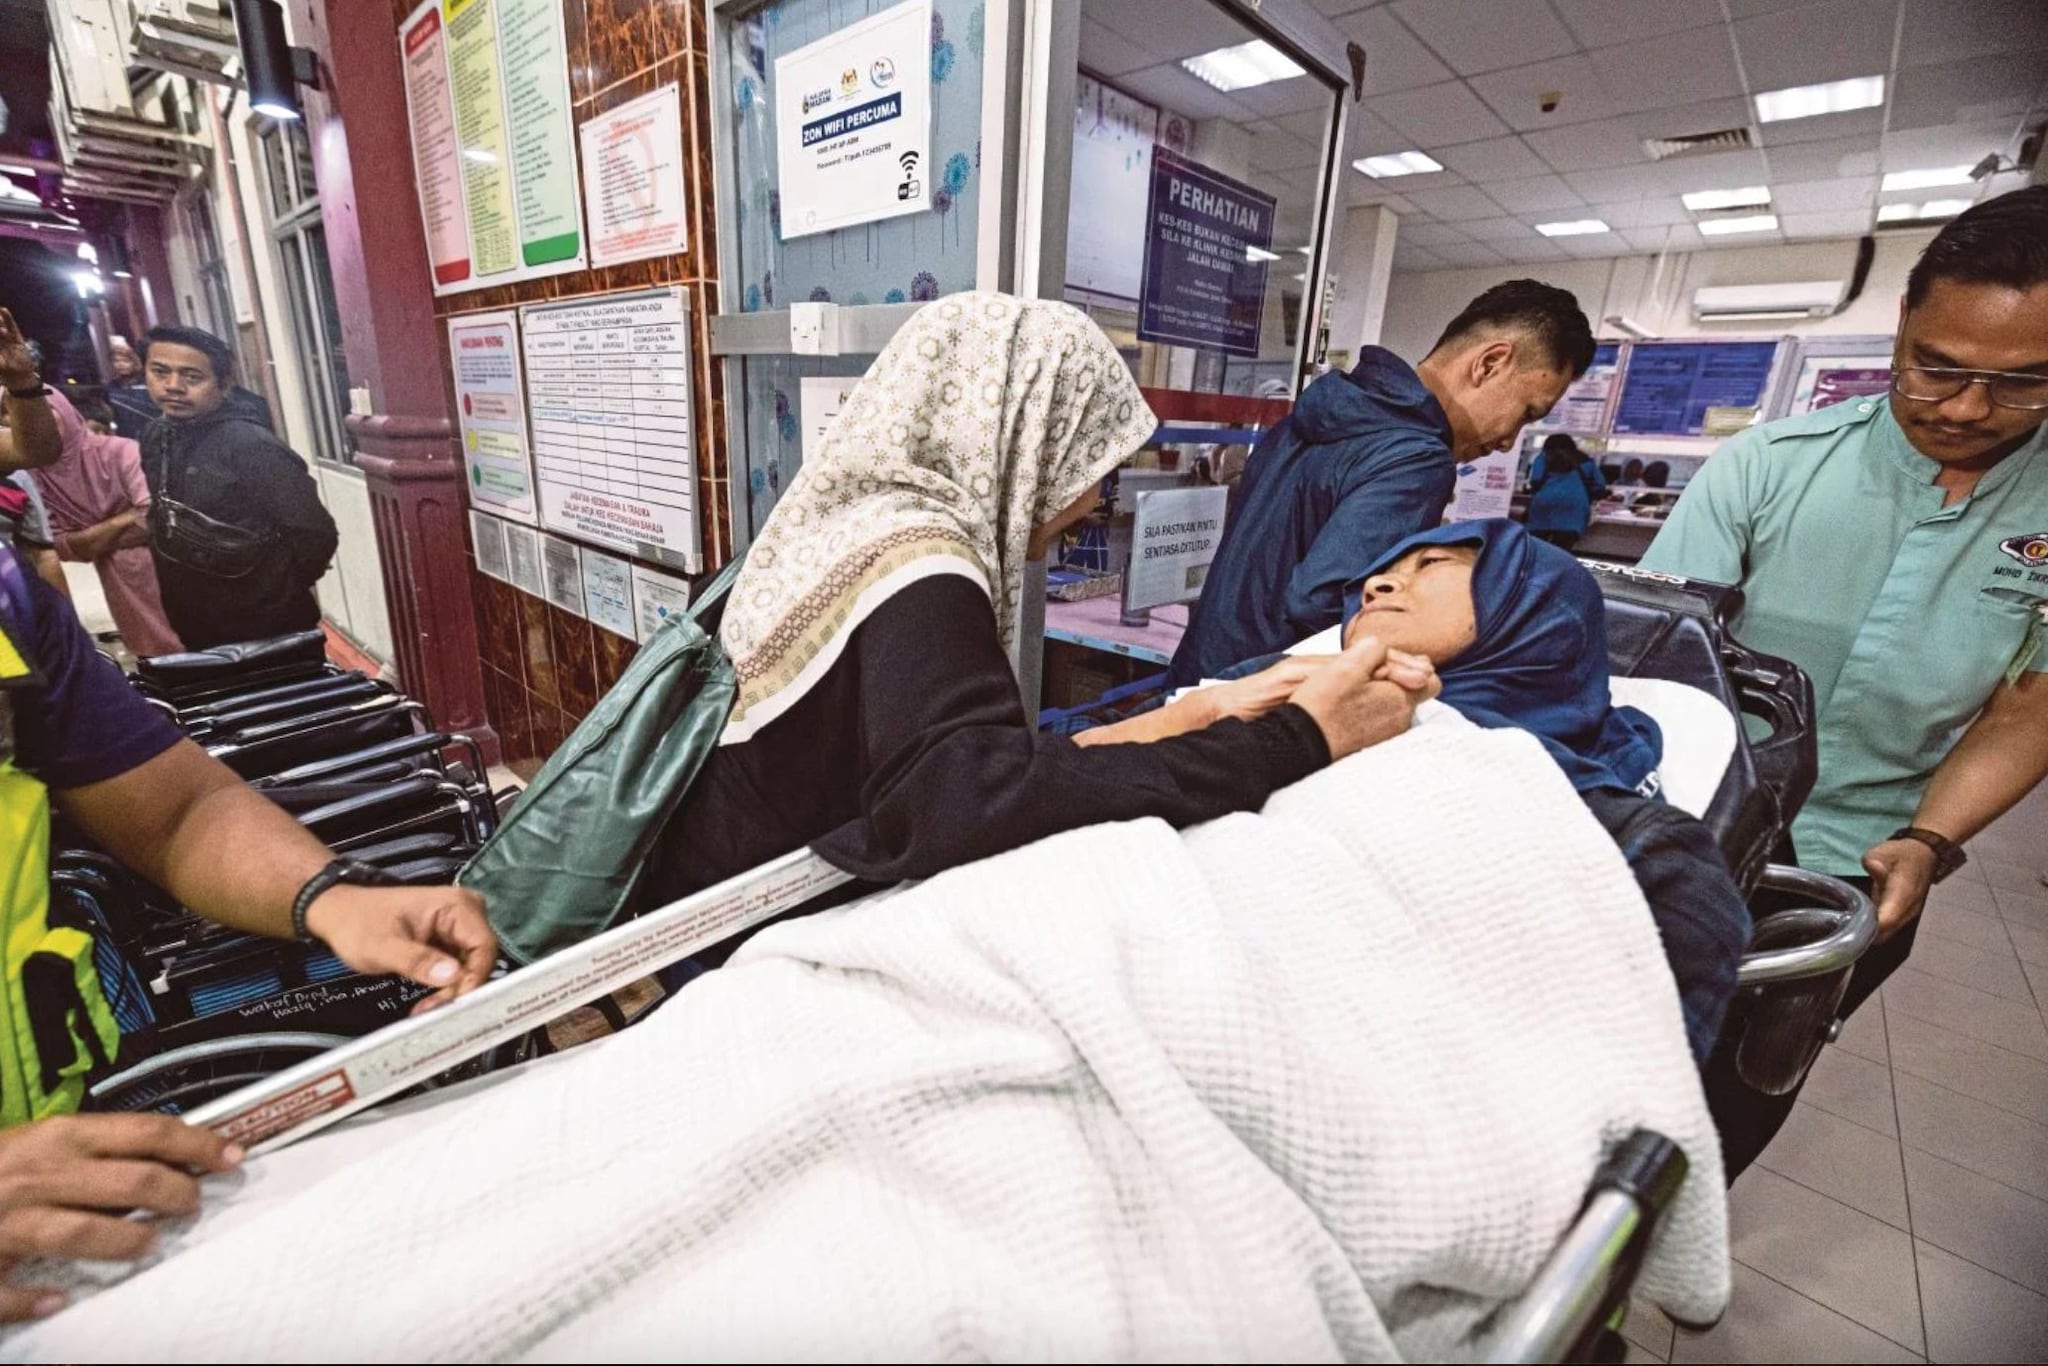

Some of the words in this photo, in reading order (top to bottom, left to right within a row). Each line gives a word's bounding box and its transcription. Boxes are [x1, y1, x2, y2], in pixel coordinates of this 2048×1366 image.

[803, 126, 822, 143] ZON
[824, 118, 845, 136] WIFI
[846, 100, 898, 129] PERCUMA
[1169, 177, 1259, 233] PERHATIAN
[1159, 212, 1193, 234] KES-KES
[1195, 224, 1220, 242] BUKAN
[1160, 229, 1180, 243] SILA
[1181, 236, 1193, 248] KE
[1193, 241, 1219, 257] KLINIK
[1187, 250, 1211, 268] JALAN
[1144, 526, 1160, 538] SILA
[1162, 521, 1196, 536] PASTIKAN
[1197, 519, 1218, 532] PINTU
[1144, 543, 1179, 559] SENTIASA
[1993, 566, 2022, 578] MOHD
